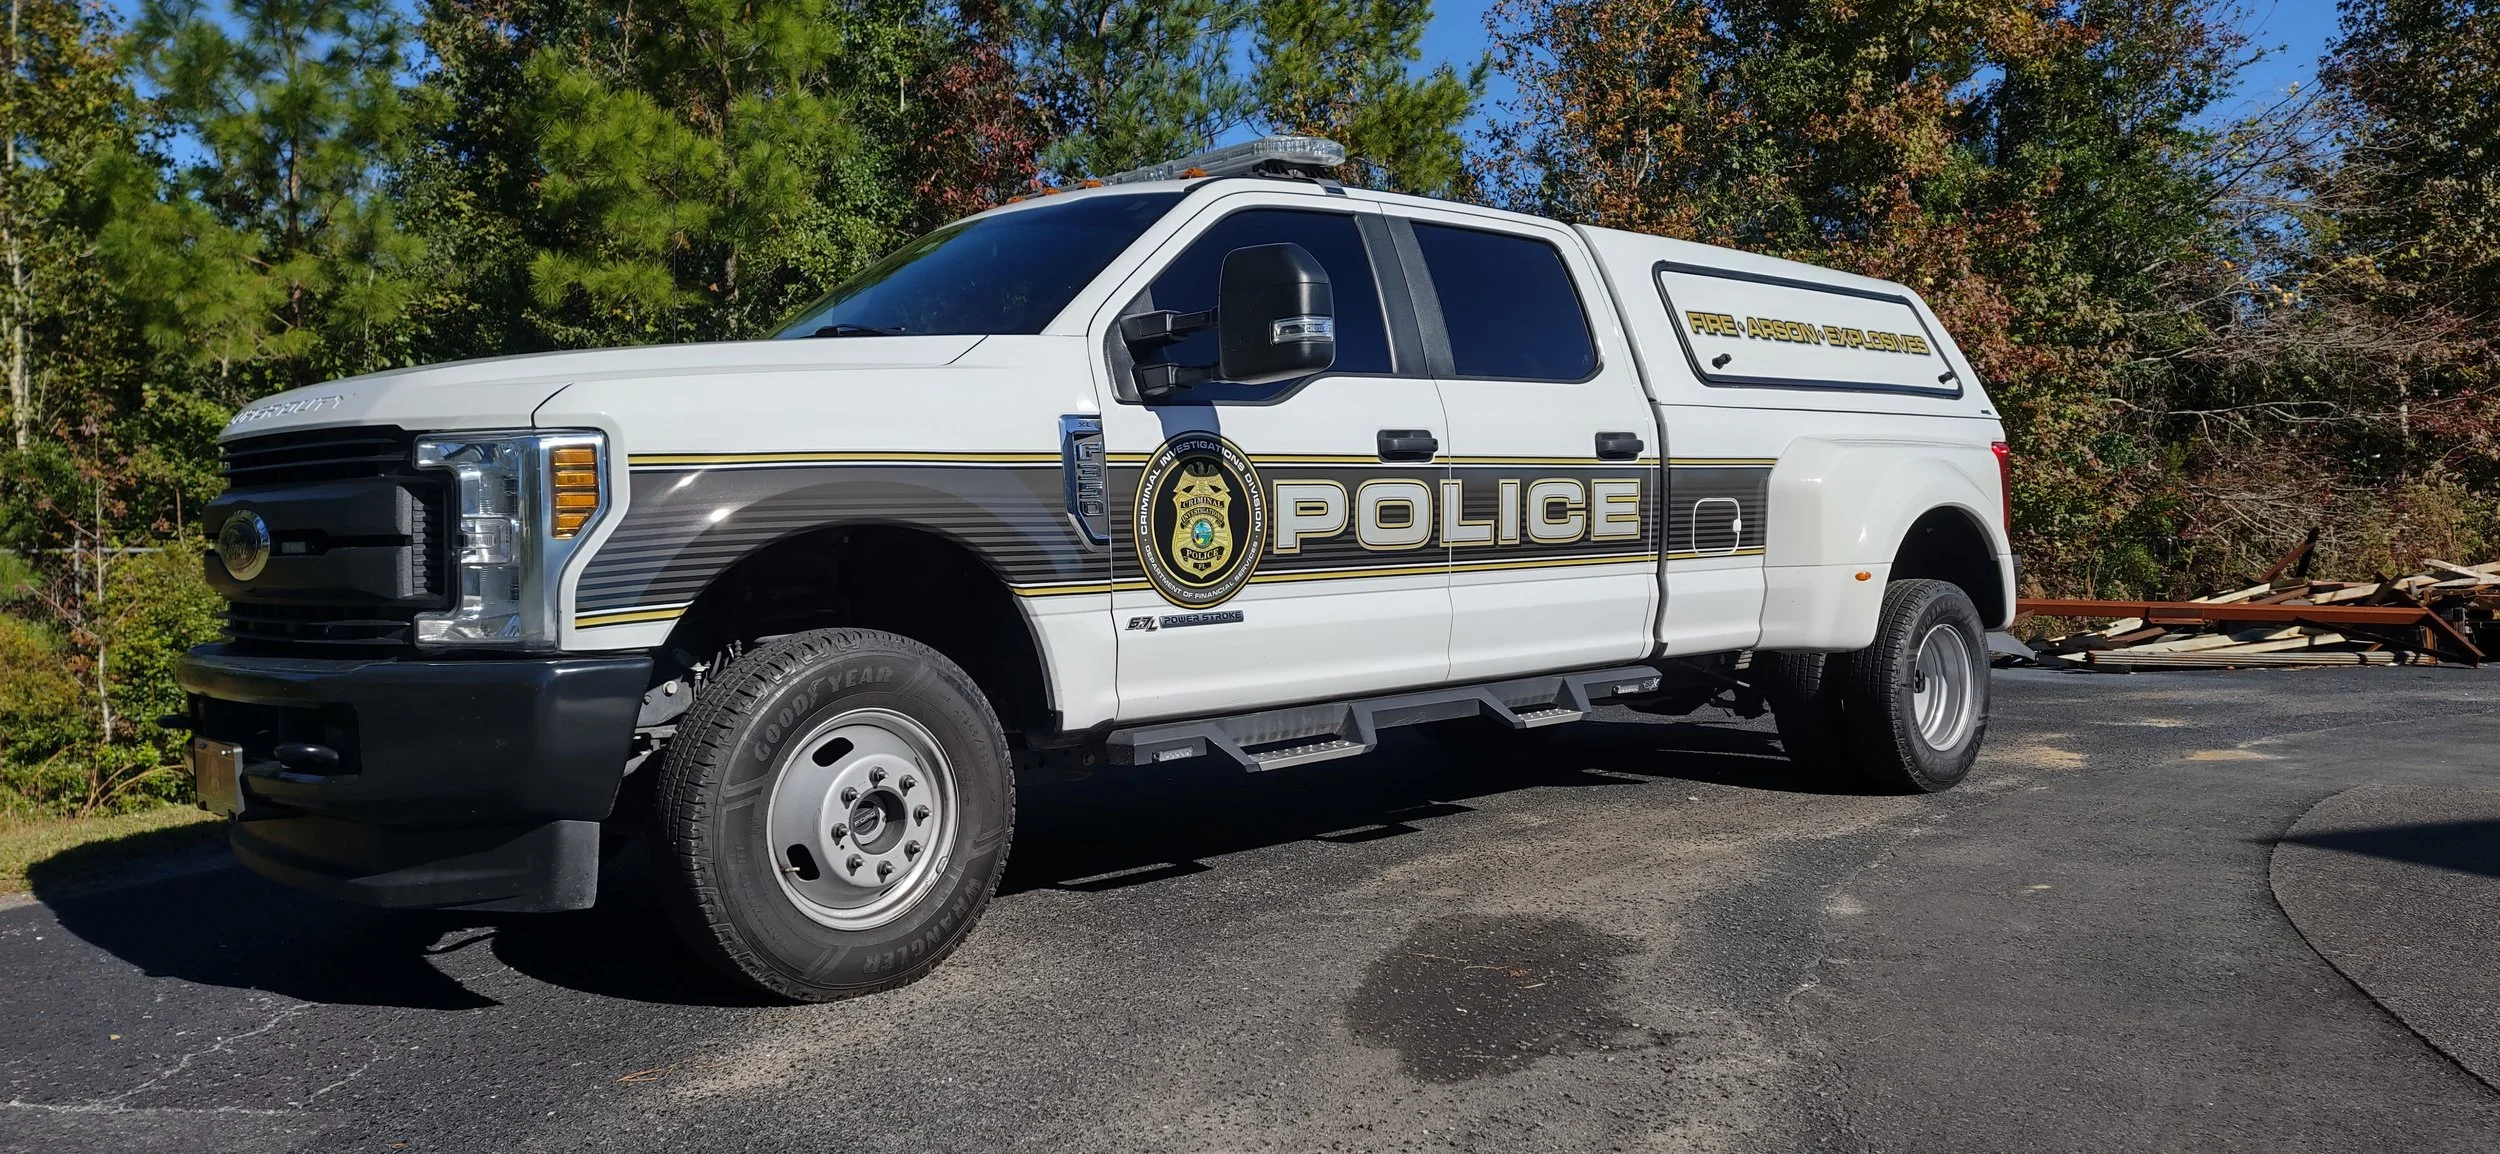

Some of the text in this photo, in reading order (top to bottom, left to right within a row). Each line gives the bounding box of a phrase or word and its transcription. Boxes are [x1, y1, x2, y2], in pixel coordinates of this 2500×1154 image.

[1686, 311, 1931, 356] FIRE ARSON EXPLOSIVES
[226, 395, 344, 428] UPER DUTY
[1140, 440, 1263, 536] CRIMINAL INVESTIGATIONS DIVISION
[1181, 496, 1224, 508] CRIMINAL
[1179, 506, 1225, 522] INVESTIGATIONS
[1272, 478, 1641, 555] POLICE
[1144, 541, 1259, 599] DEPARTMENT OF FINANCIAL SERVICES
[1185, 547, 1220, 560] POLICE
[1198, 562, 1207, 570] FL
[1163, 613, 1200, 625] POWER
[1201, 610, 1242, 622] STROKE
[754, 665, 895, 762] GOODYEAR
